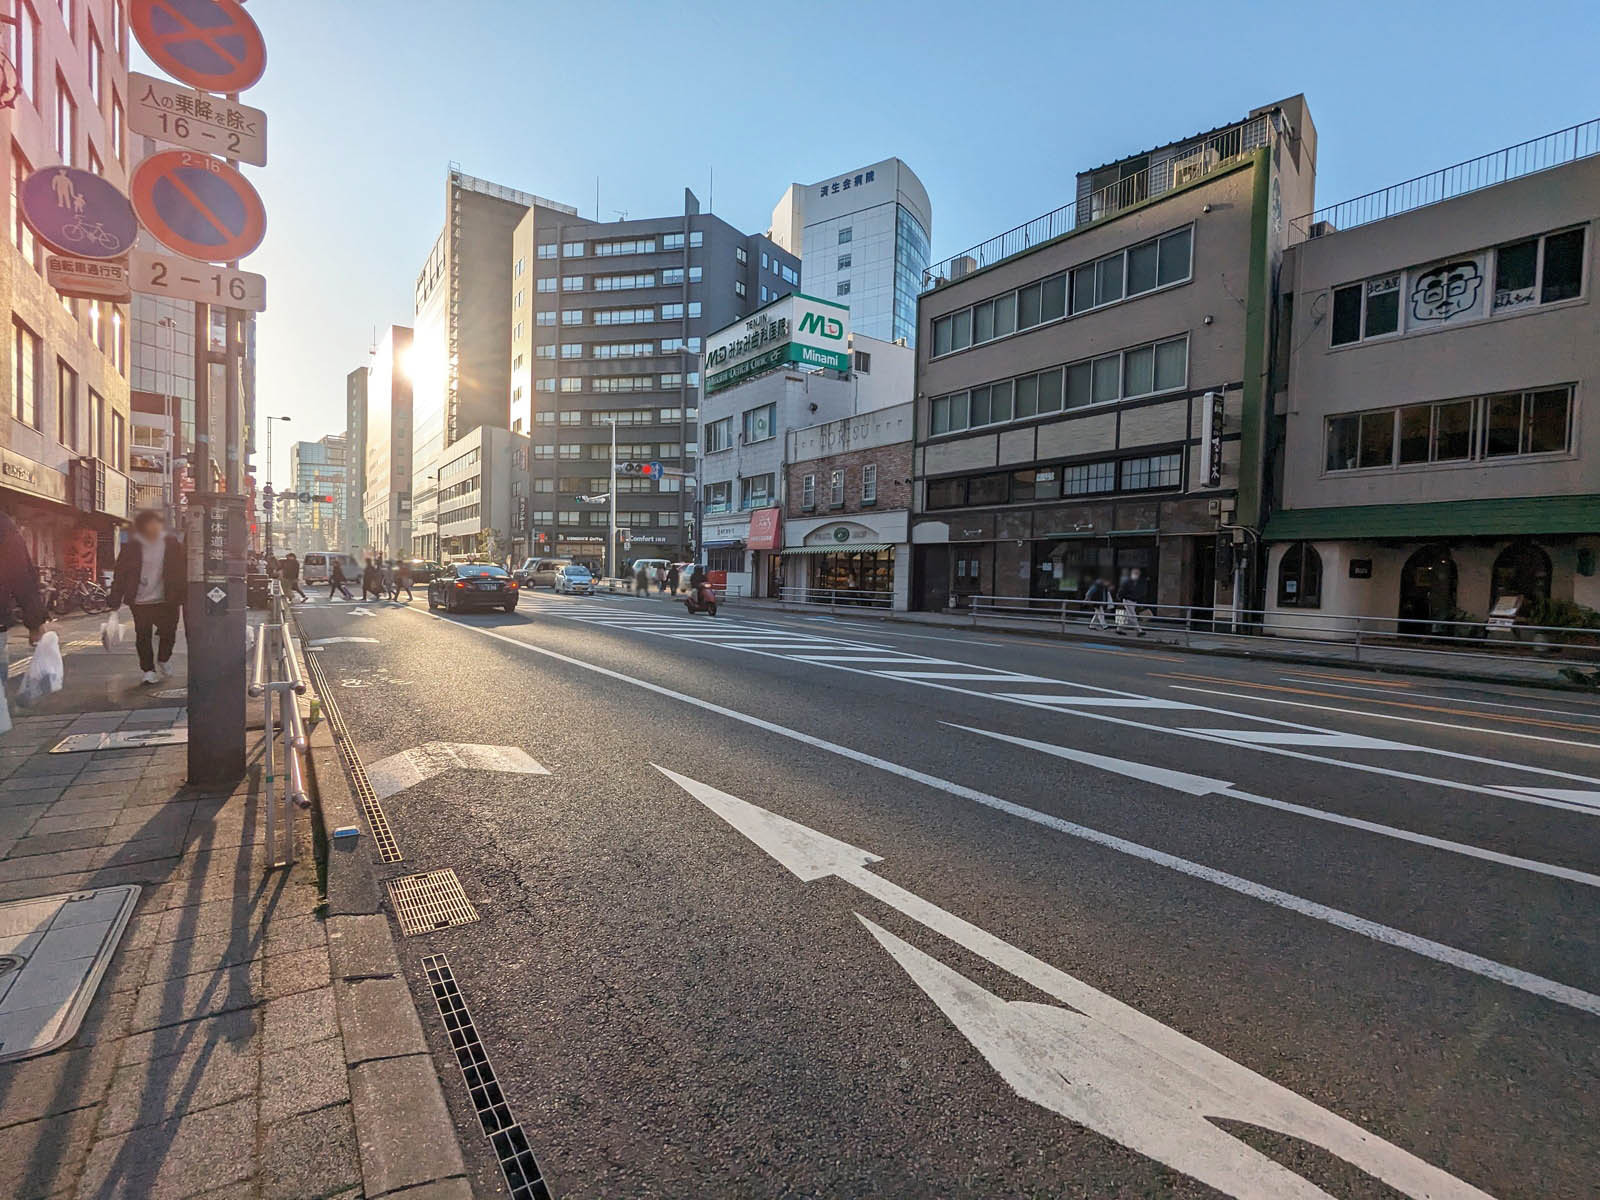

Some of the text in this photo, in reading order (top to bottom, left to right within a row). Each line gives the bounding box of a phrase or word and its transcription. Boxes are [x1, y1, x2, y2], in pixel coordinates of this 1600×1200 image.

[140, 84, 257, 135] 人の乗降を除く
[820, 170, 876, 198] 済生会病院
[49, 259, 123, 280] 自転車通行可
[745, 313, 768, 332] TENJIN
[728, 317, 788, 360] みなみ歯科医院
[802, 347, 839, 367] Minami
[629, 535, 655, 543] Comfort
